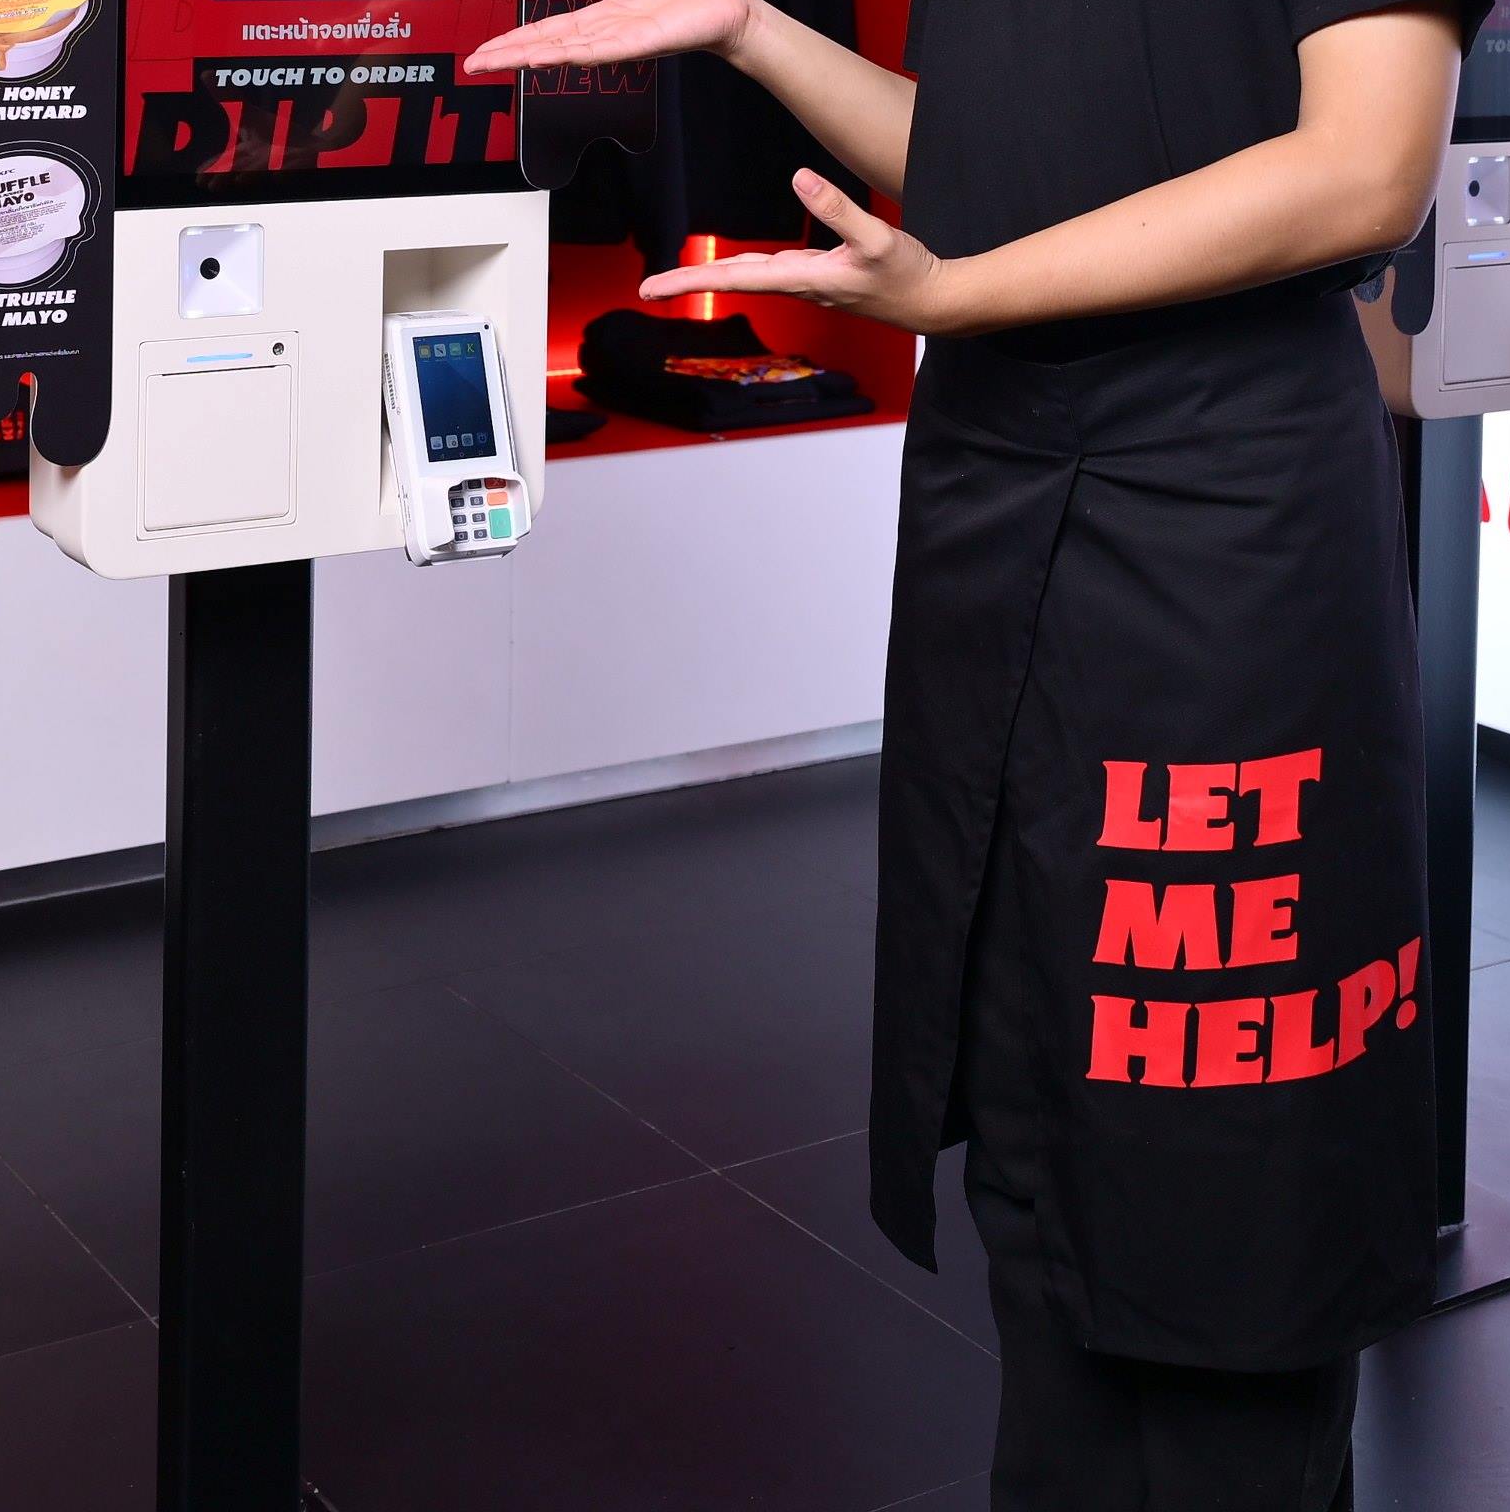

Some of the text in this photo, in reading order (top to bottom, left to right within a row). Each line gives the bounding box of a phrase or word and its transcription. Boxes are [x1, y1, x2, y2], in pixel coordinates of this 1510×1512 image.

[242, 11, 412, 41] แตะหน้าจอเพื่อสั่ง
[215, 65, 436, 87] TOUCH TO ORDER
[2, 86, 76, 101] HONEY
[1, 309, 68, 327] MAYO
[1096, 747, 1323, 852] LET
[1092, 873, 1301, 970] ME
[1085, 935, 1421, 1088] HELP!
